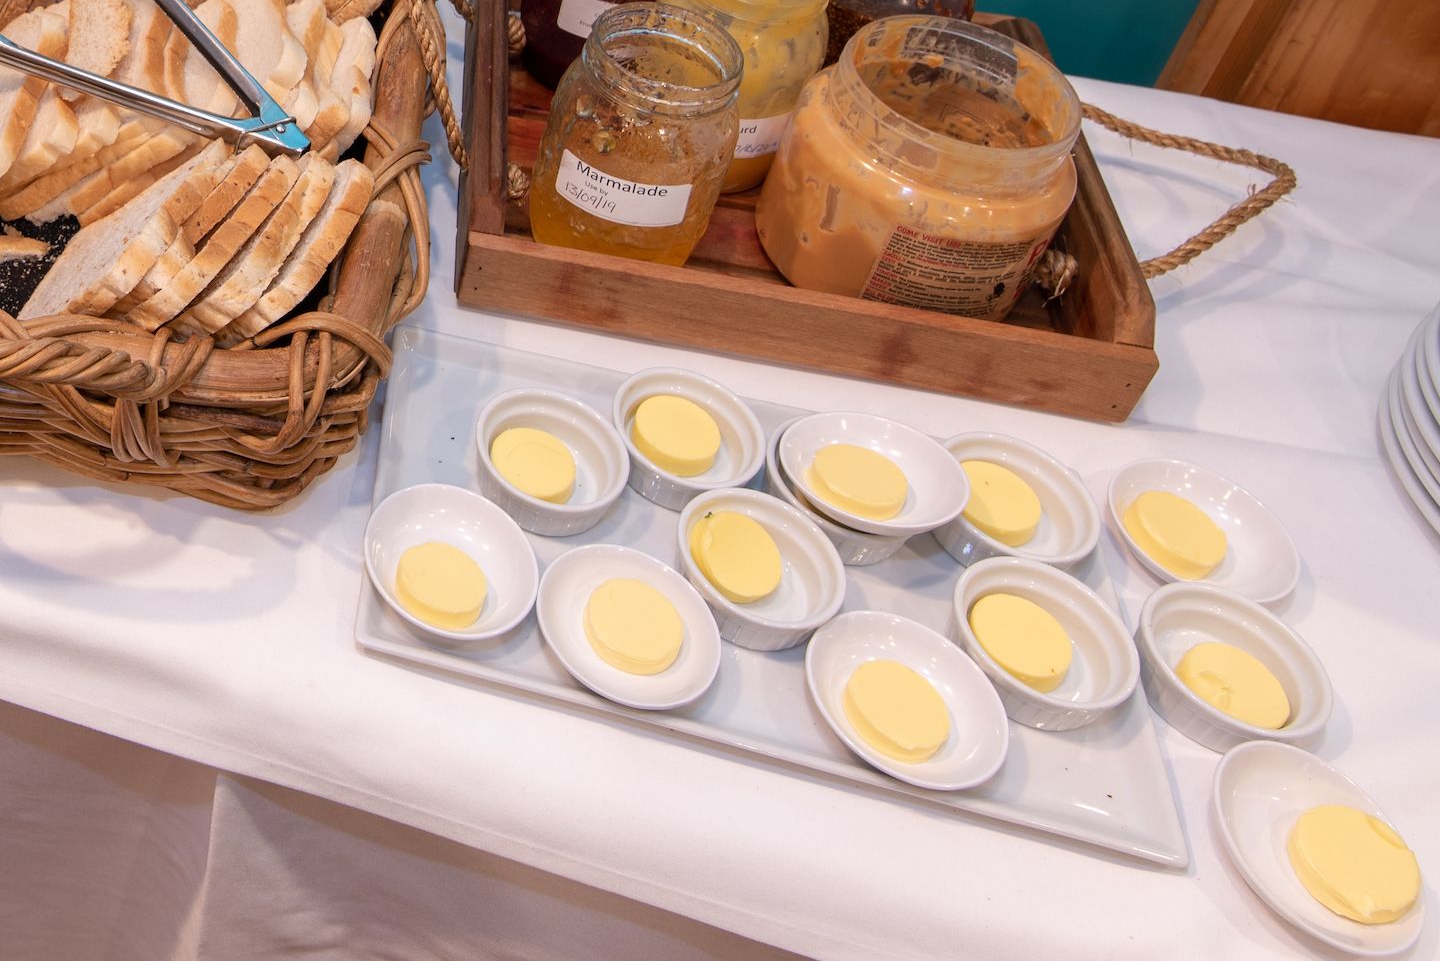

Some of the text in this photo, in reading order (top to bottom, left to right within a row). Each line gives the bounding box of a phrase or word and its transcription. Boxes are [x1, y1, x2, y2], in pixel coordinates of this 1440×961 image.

[576, 160, 668, 197] Marmalade
[584, 180, 609, 196] Use by
[565, 181, 617, 213] 13/09/19
[896, 225, 918, 238] COME
[922, 234, 943, 246] VISIT
